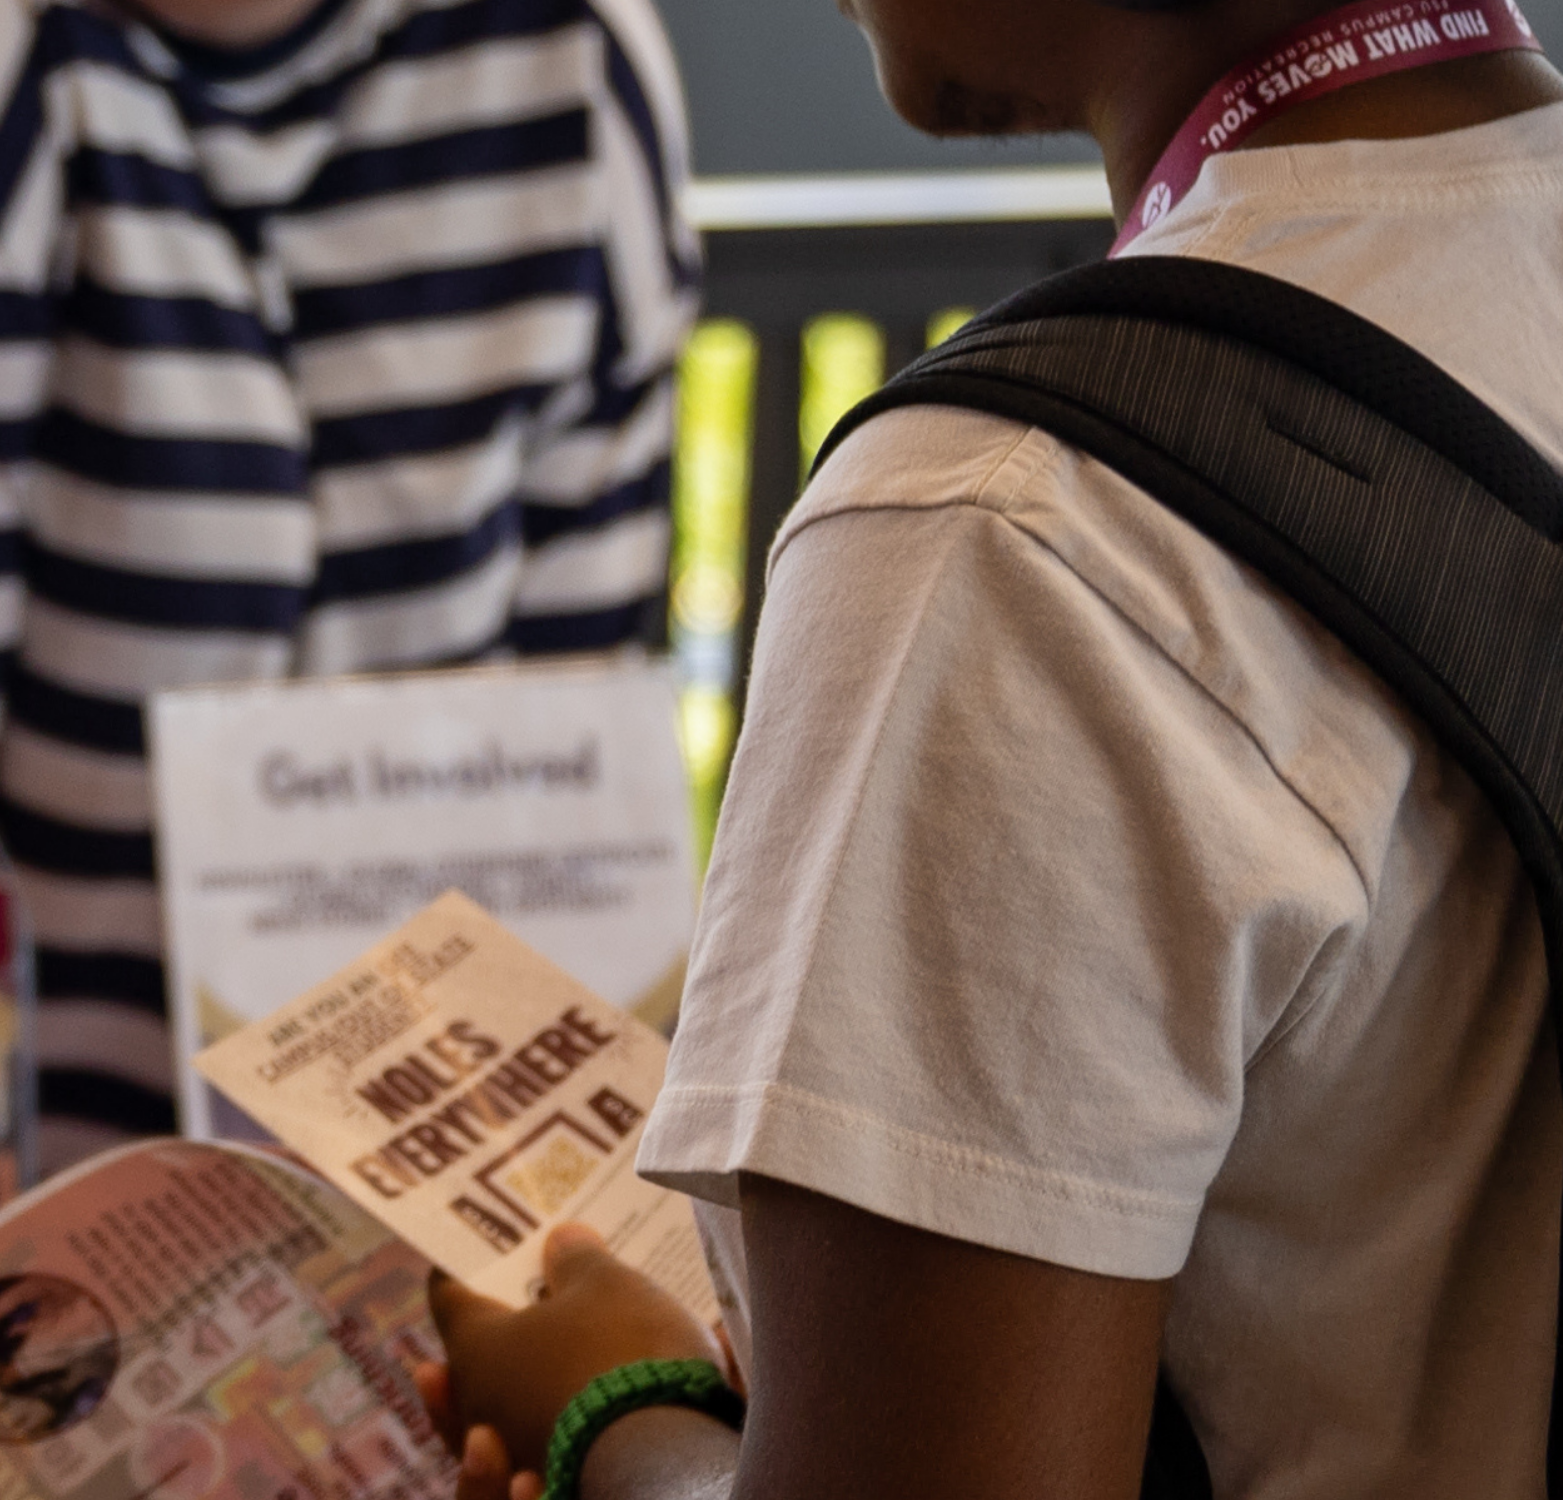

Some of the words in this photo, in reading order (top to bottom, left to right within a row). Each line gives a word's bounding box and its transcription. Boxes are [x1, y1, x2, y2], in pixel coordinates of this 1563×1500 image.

[1339, 3, 1414, 36] CAMPUS
[1362, 19, 1441, 61] WHAT
[1440, 9, 1490, 41] FIND
[1223, 31, 1334, 105] RECREATION
[1257, 39, 1361, 104] MOVES
[1200, 97, 1258, 150] YOU.
[256, 744, 355, 807] Get
[368, 734, 601, 797] Involved
[351, 1004, 618, 1199] EVERYWHERE
[356, 1018, 502, 1126] NOLES
